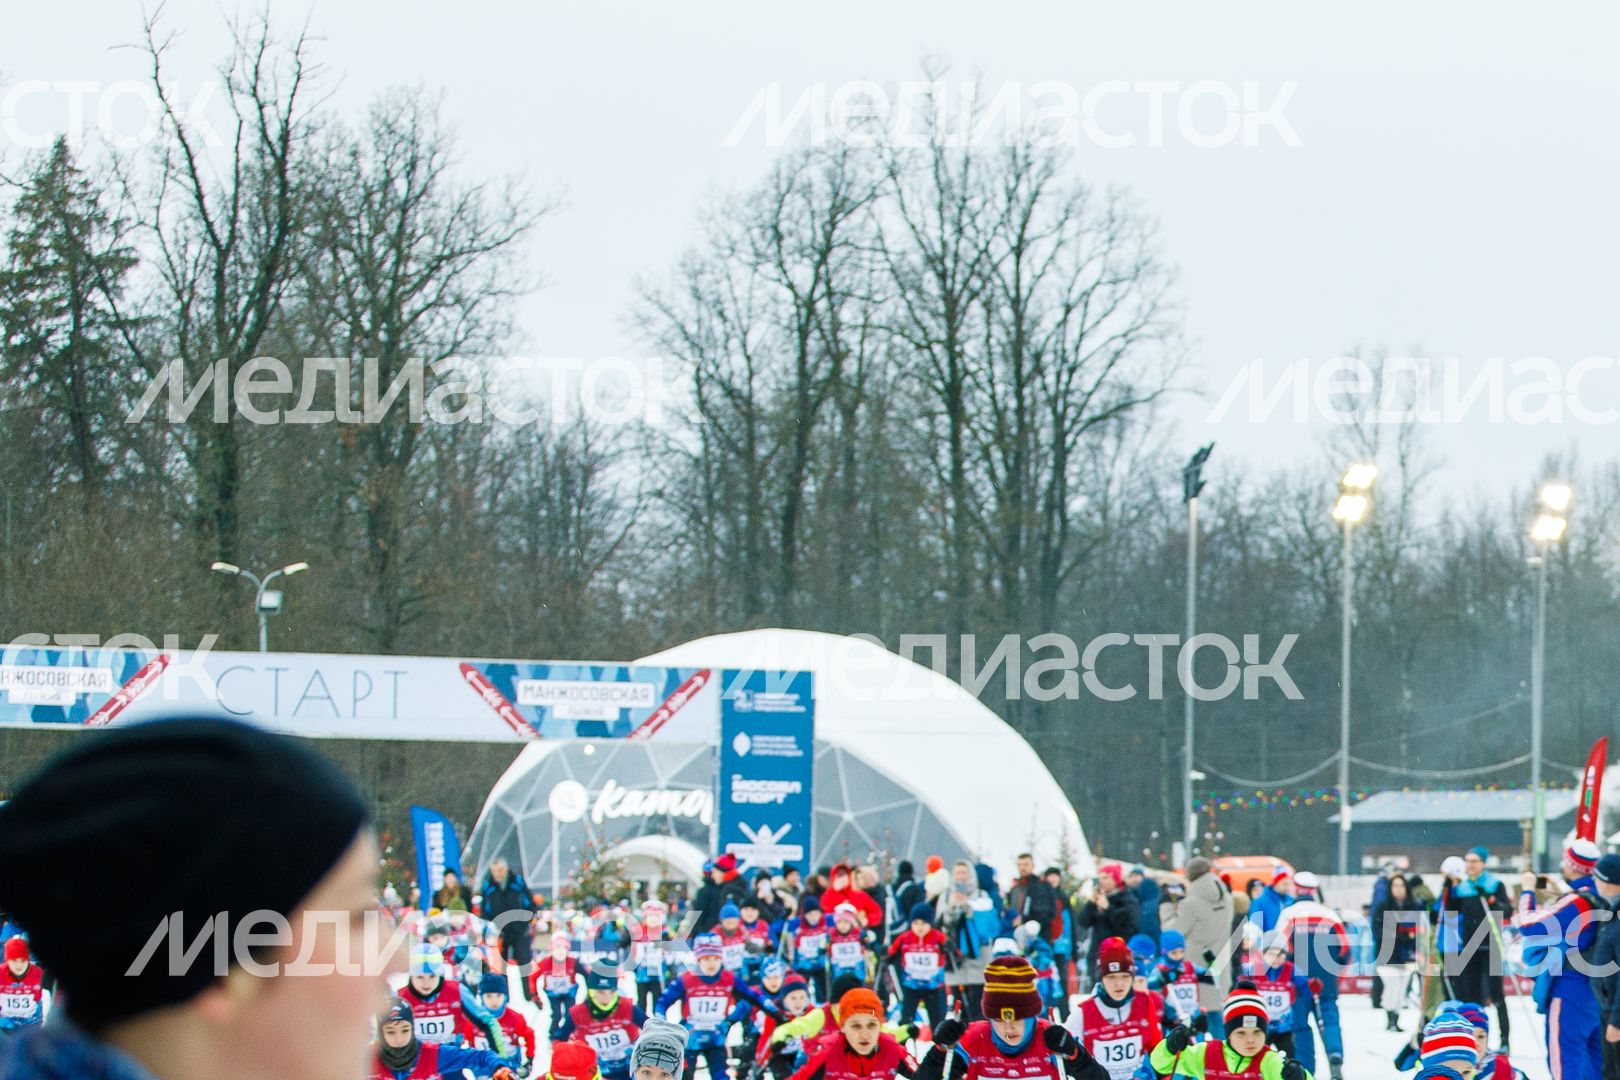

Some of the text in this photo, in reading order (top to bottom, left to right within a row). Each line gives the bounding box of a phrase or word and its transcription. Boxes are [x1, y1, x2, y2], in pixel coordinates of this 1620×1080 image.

[216, 665, 408, 719] СТАРТ
[522, 685, 651, 701] МАНЖОСОВСКАЯ
[7, 997, 30, 1009] 153
[1266, 995, 1283, 1007] 48
[419, 1021, 445, 1035] 101
[594, 1033, 621, 1049] 118
[1103, 1042, 1136, 1063] 130
